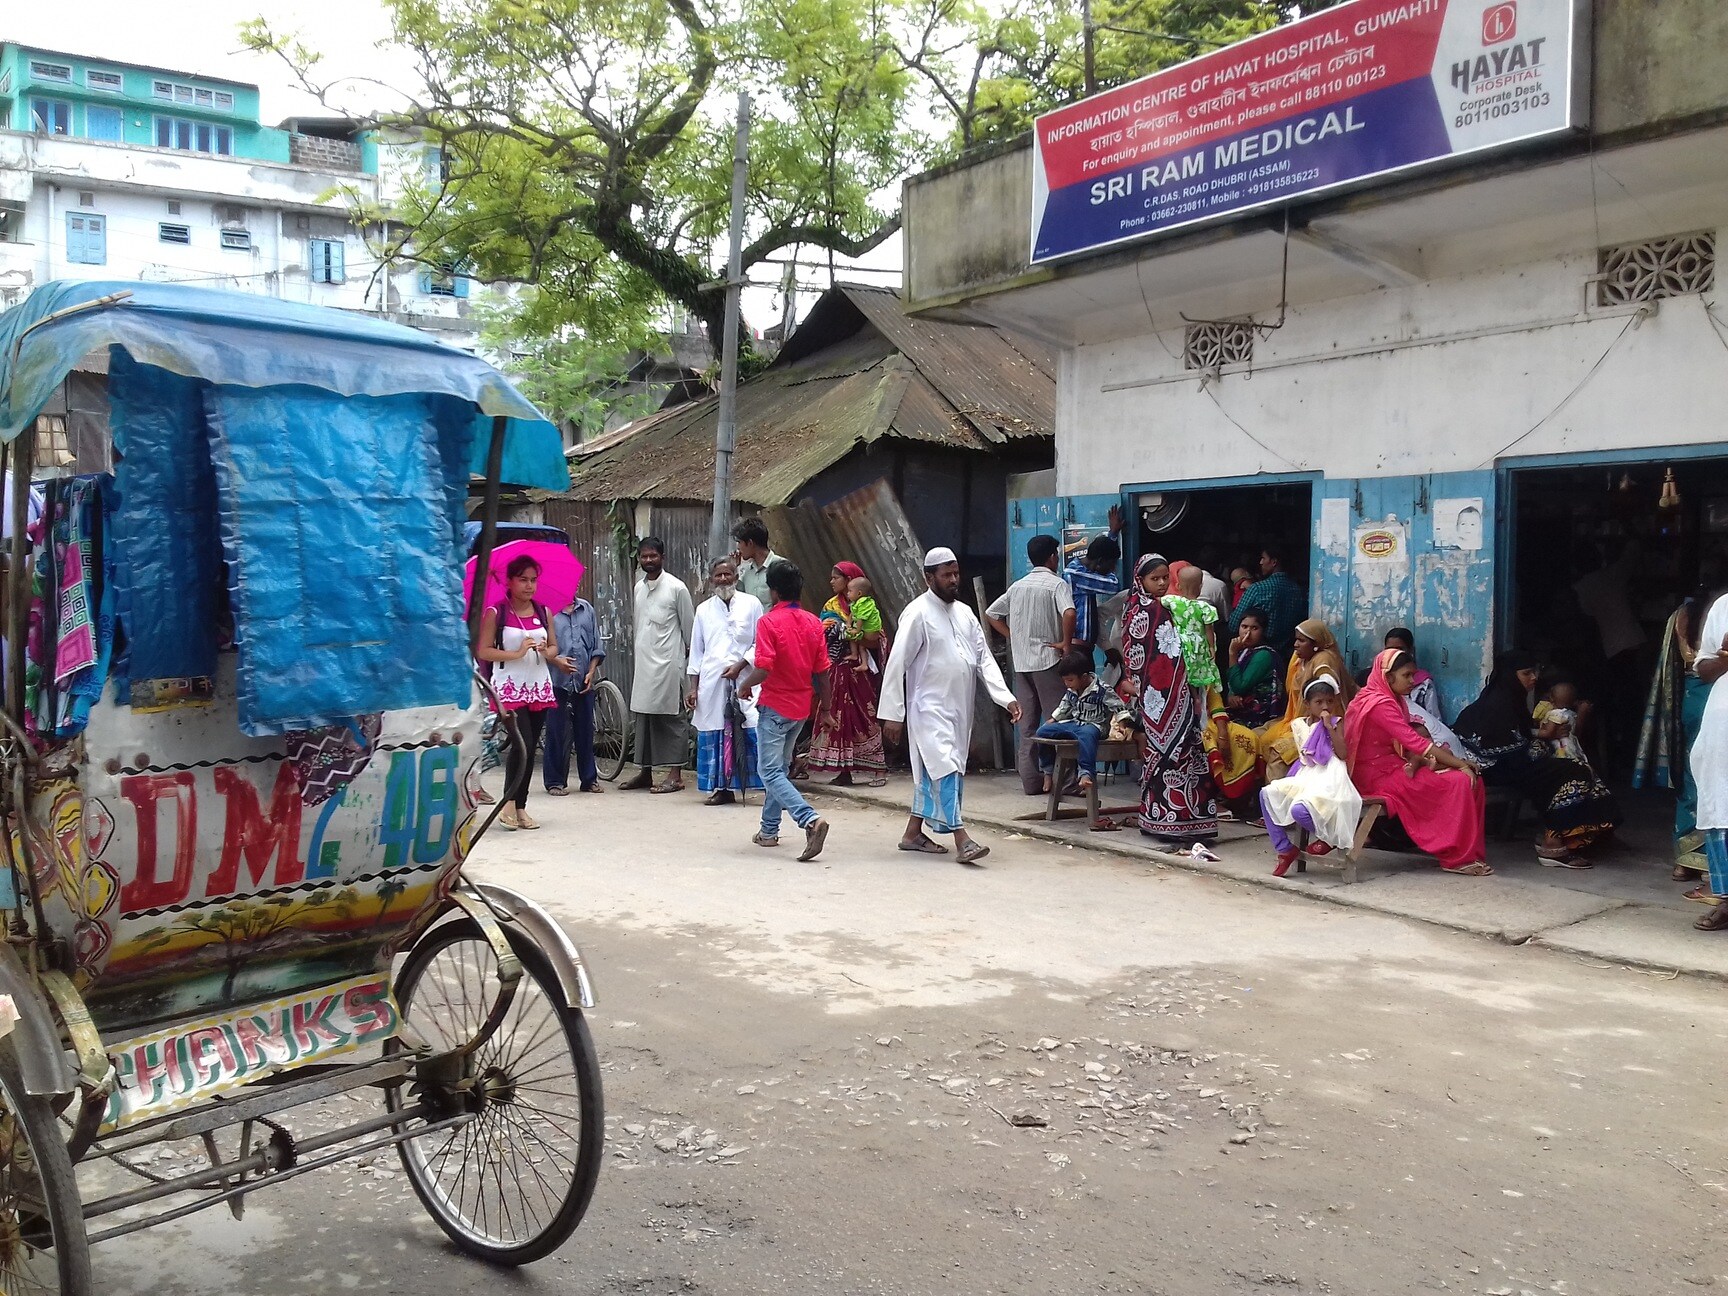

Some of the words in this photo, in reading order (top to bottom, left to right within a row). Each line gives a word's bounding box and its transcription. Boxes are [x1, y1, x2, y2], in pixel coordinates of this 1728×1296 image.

[1047, 104, 1130, 144] INFORMATION
[1133, 83, 1187, 113] CENTRE
[1190, 74, 1210, 92] OF
[1214, 57, 1262, 86] HAYAT
[1265, 29, 1348, 68] HOSPITAL,
[1354, 0, 1439, 37] GUWAHTI
[1451, 37, 1547, 95] HAYAT
[1475, 68, 1541, 94] HOSPITAL
[1454, 92, 1550, 129] 8011003103
[1460, 87, 1512, 112] Corporate
[1515, 81, 1542, 98] Desk
[1083, 159, 1099, 172] For
[1101, 145, 1139, 166] enquiry
[1140, 137, 1160, 153] and
[1163, 114, 1235, 147] appointment,
[1238, 103, 1276, 125] please
[1280, 91, 1302, 109] call
[1305, 80, 1342, 101] 88110
[1346, 64, 1386, 87] 00123
[1090, 173, 1133, 206] SRI
[1141, 152, 1205, 191] RAM
[1214, 106, 1366, 170] MEDICAL
[1183, 183, 1209, 198] ROAD
[1210, 171, 1247, 191] DHUBRI
[1248, 159, 1291, 182] (ASSAM)
[1120, 216, 1145, 230] Phone
[1210, 190, 1240, 206] Mobile
